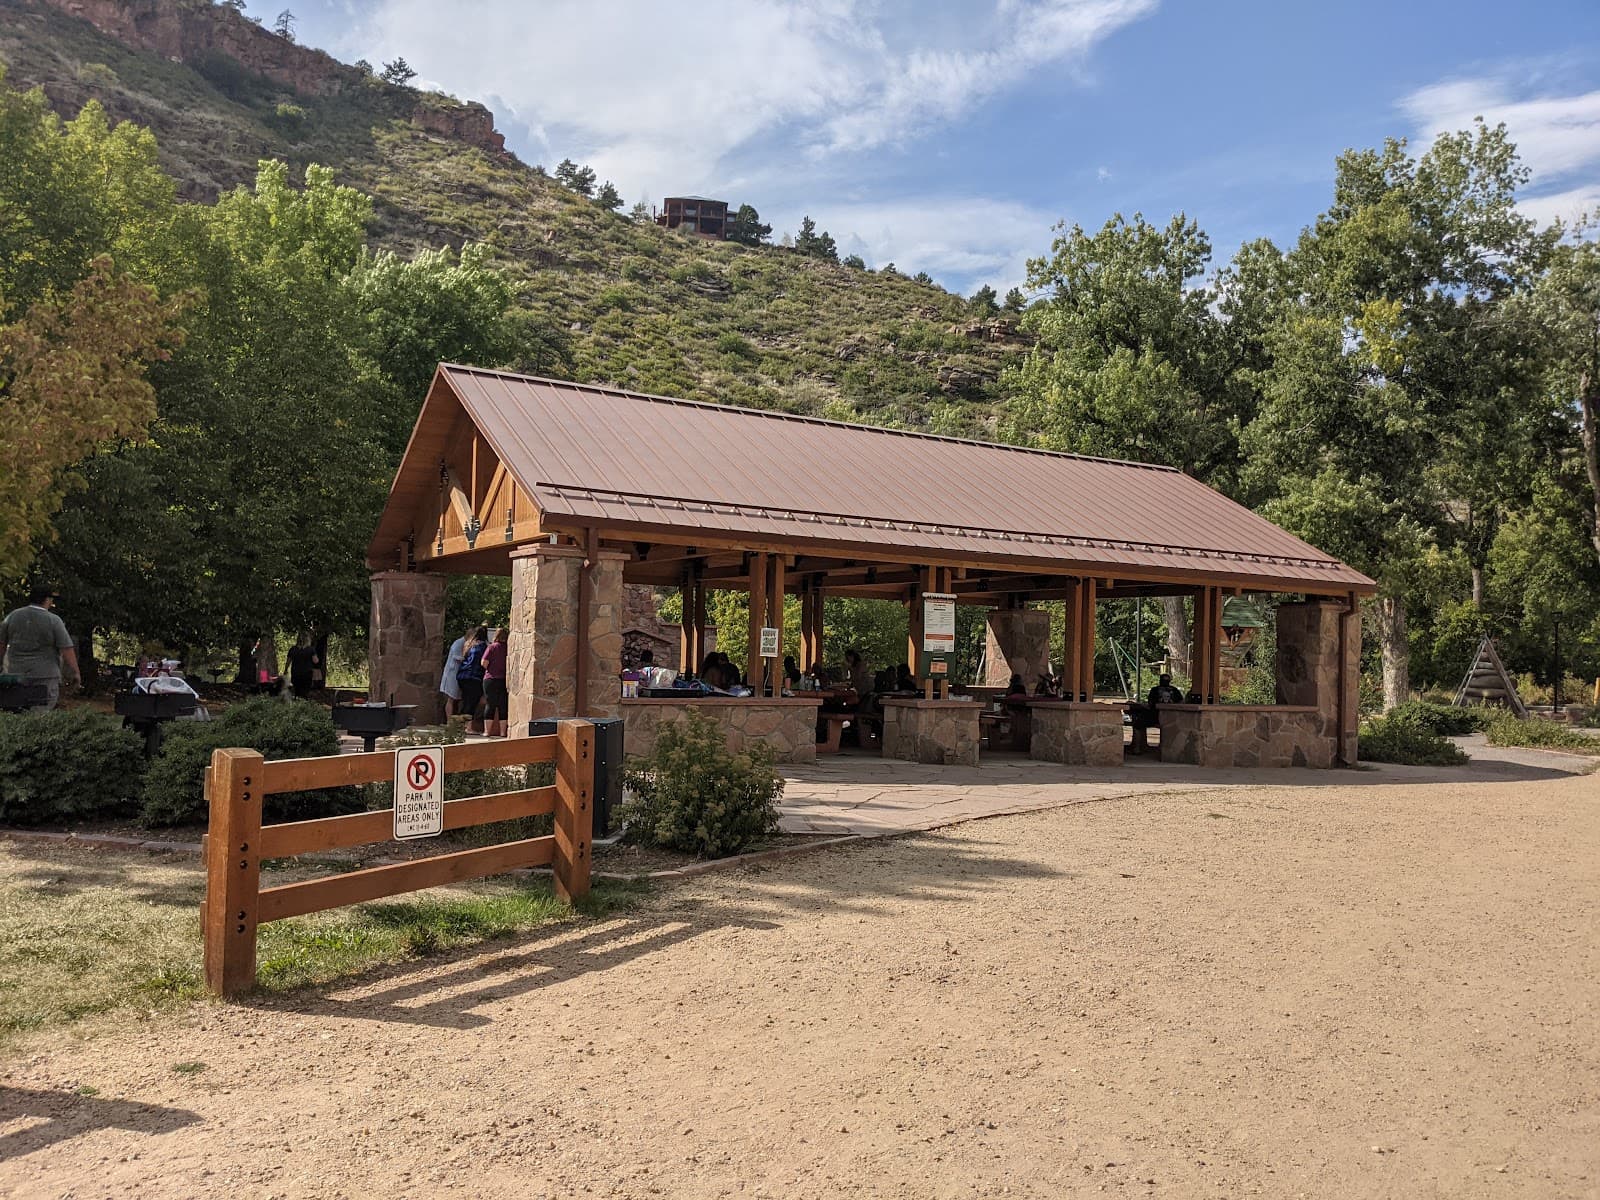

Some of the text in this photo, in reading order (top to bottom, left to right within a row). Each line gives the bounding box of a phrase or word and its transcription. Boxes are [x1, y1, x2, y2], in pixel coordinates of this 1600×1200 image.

[406, 792, 432, 802] PARK IN
[398, 802, 439, 813] DESIGNATED
[398, 812, 440, 824] AREAS ONLY
